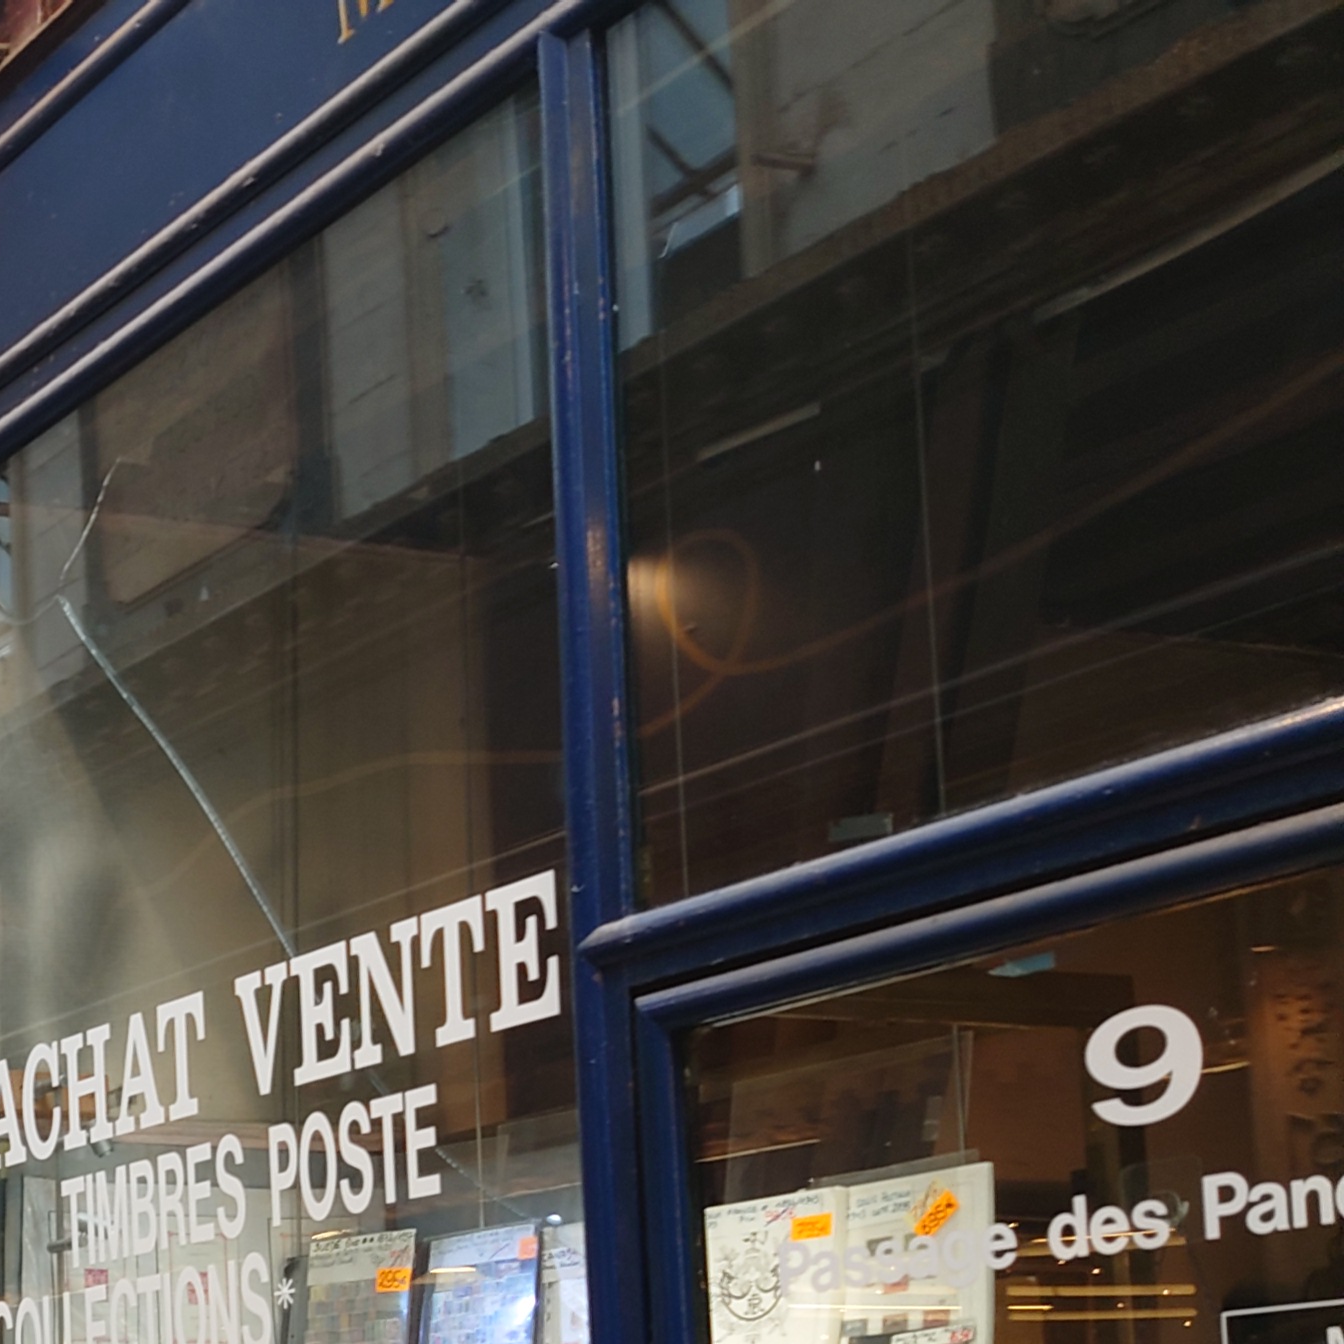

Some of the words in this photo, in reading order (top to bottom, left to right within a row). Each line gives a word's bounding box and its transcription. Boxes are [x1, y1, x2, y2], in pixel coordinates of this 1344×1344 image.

[233, 869, 562, 1098] VENTE
[1084, 1004, 1204, 1127] 9
[60, 1133, 245, 1269] TIMBRES
[268, 1082, 443, 1229] POSTE
[777, 1219, 1018, 1298] Passage
[1046, 1194, 1170, 1262] des
